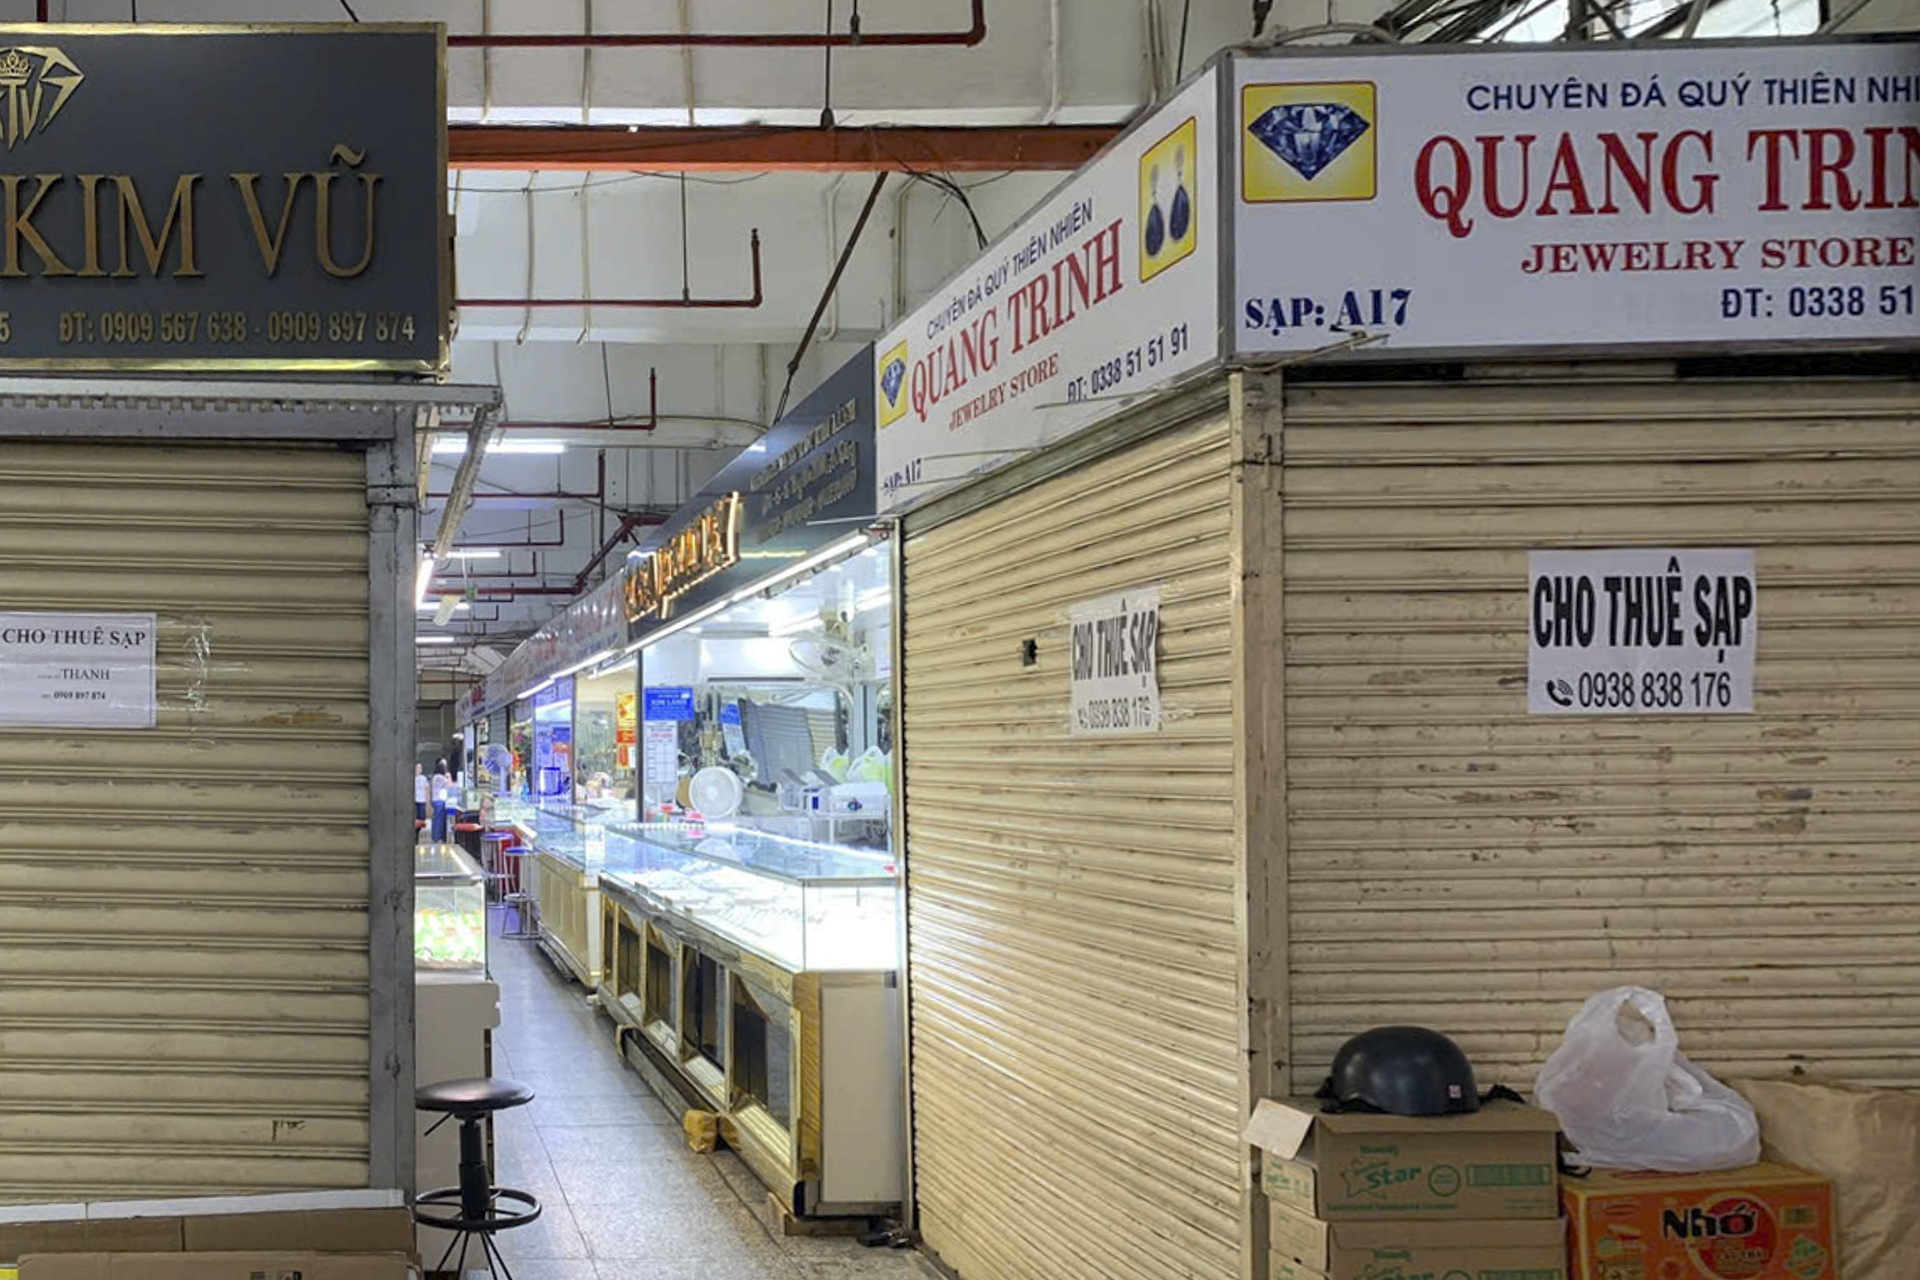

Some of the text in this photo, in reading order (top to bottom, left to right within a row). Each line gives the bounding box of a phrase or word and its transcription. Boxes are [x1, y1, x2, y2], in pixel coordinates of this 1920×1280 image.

[1467, 76, 1607, 111] CHUYÊN
[1621, 75, 1662, 109] ĐÁ
[1678, 72, 1750, 107] QUÝ
[1764, 72, 1855, 105] THIÊN
[1414, 130, 1719, 238] QUANG
[0, 143, 383, 279] KIM VŨ
[927, 197, 1093, 339] CHUYÊN ĐÁ QUÝ THIÊN NHIÊN
[1522, 236, 1915, 274] JEWELRY STORE
[911, 217, 1124, 423] QUANG TRINH
[1244, 288, 1412, 336] SẠP: A17
[1721, 284, 1914, 318] ĐT: 0338 51
[59, 311, 94, 343] ĐT:
[102, 311, 154, 343] 0909
[160, 311, 200, 343] 567
[206, 311, 247, 343] 638
[267, 311, 320, 343] 0909
[328, 311, 366, 343] 897
[375, 311, 416, 343] 874
[1091, 357, 1122, 395] 0338
[1126, 346, 1142, 377] 51
[1148, 335, 1164, 367] 51
[1170, 321, 1188, 356] 91
[949, 353, 1059, 432] JEWELRY STORE
[1533, 556, 1753, 663] CHO THUÊ SẠP
[2, 626, 146, 649] CHO THUÊ SẠP
[1073, 598, 1155, 688] CHO THUÊ SẠP
[60, 668, 110, 680] THANH
[1578, 671, 1731, 707] 0938 838 176
[1365, 1166, 1422, 1189] Star
